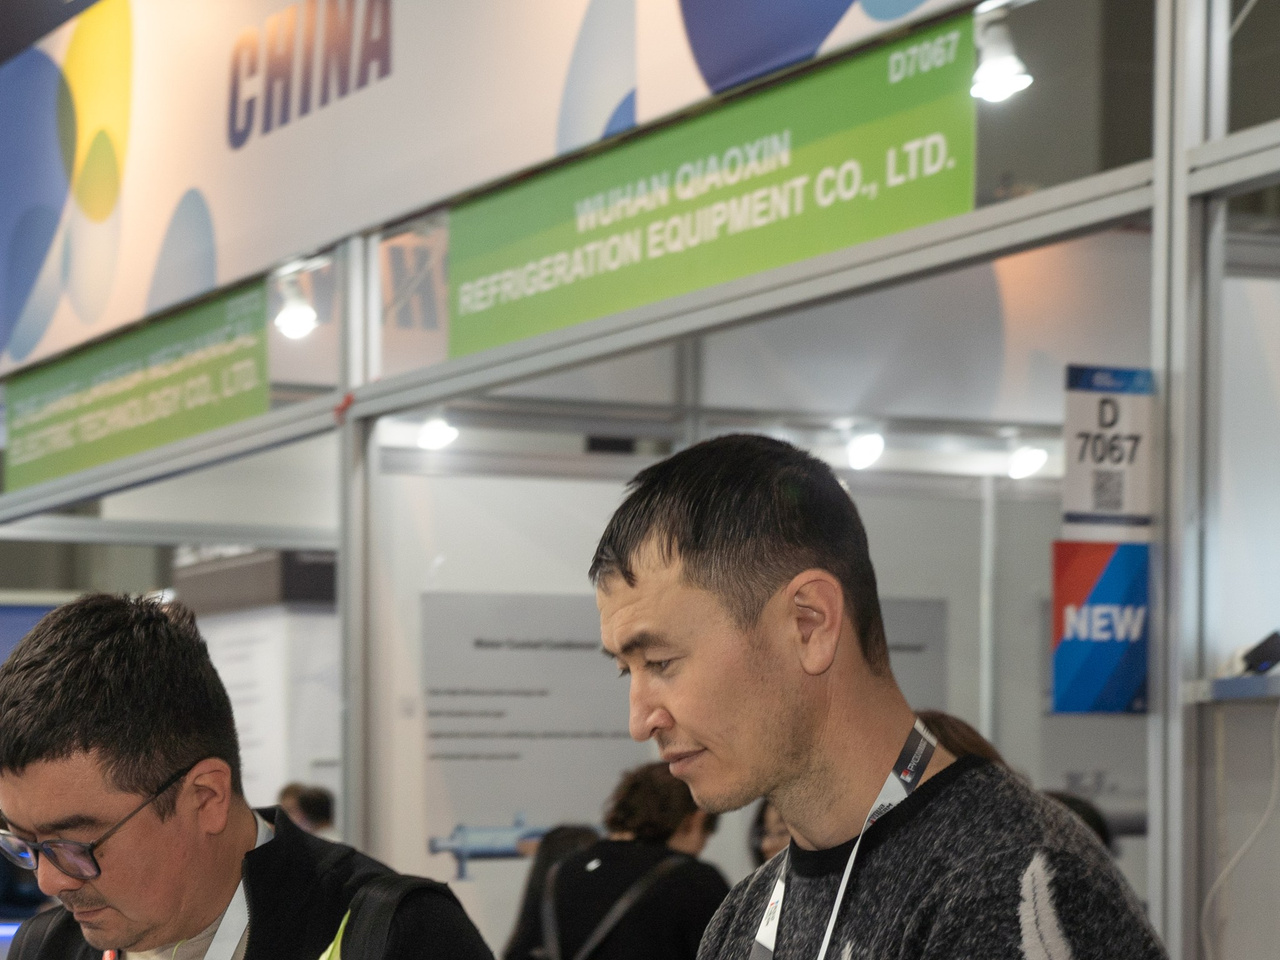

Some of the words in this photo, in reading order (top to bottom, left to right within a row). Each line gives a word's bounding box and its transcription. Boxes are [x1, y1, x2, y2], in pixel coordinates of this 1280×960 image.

[227, 0, 392, 150] CHINA
[887, 31, 961, 84] D7067
[575, 172, 671, 233] WUHAN
[676, 129, 793, 200] QIAOXIN
[457, 226, 643, 316] REFRIGERATION
[647, 178, 808, 261] EQUIPMENT
[886, 132, 956, 188] LTD.
[1098, 398, 1120, 430] D
[1076, 431, 1142, 465] 7067
[1063, 604, 1148, 642] NEW
